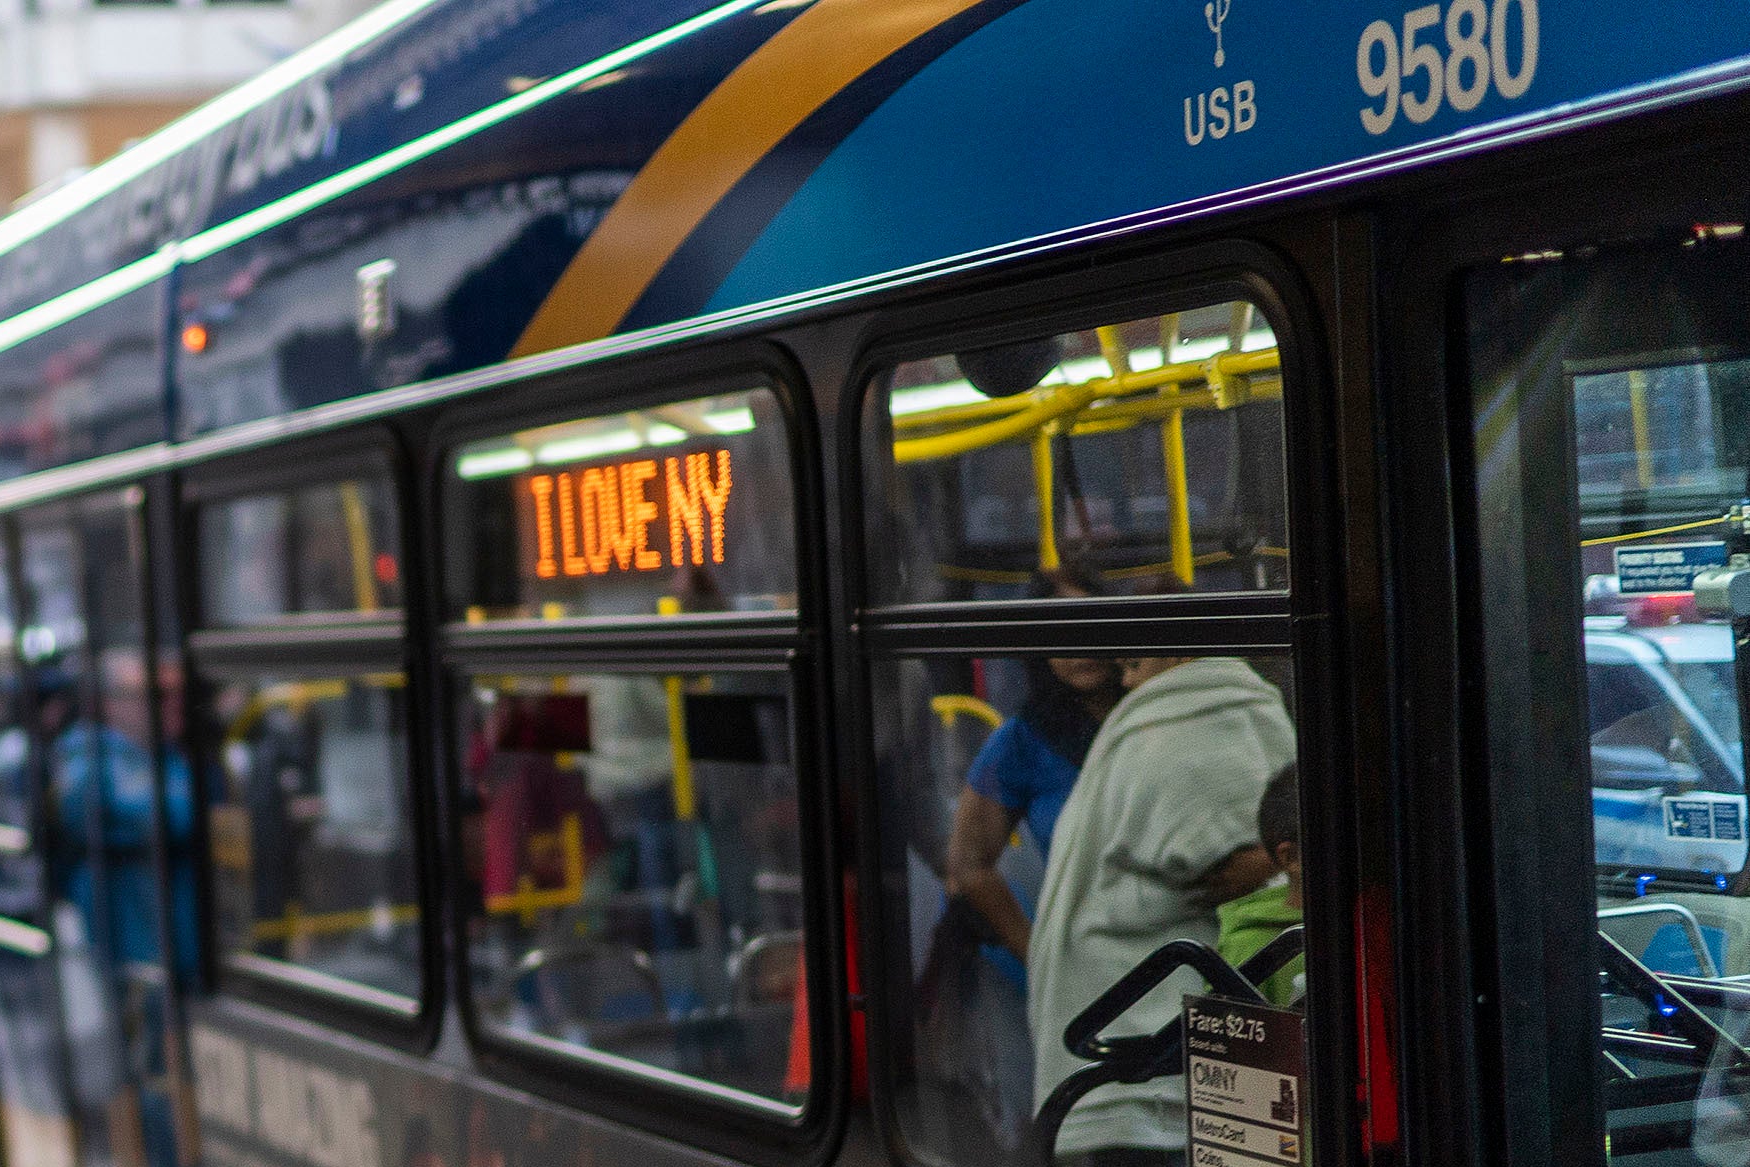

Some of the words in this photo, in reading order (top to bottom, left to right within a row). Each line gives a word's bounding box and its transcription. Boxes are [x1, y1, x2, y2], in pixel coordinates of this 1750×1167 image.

[1357, 0, 1539, 136] 9580
[1184, 80, 1257, 146] USB
[530, 474, 558, 579] I
[558, 459, 662, 576] LOVE
[665, 449, 733, 567] NY
[1188, 1007, 1225, 1035] Fare:
[1225, 1014, 1267, 1043] $2.75
[1193, 1061, 1239, 1092] OMNY
[1194, 1116, 1246, 1144] MetroCard
